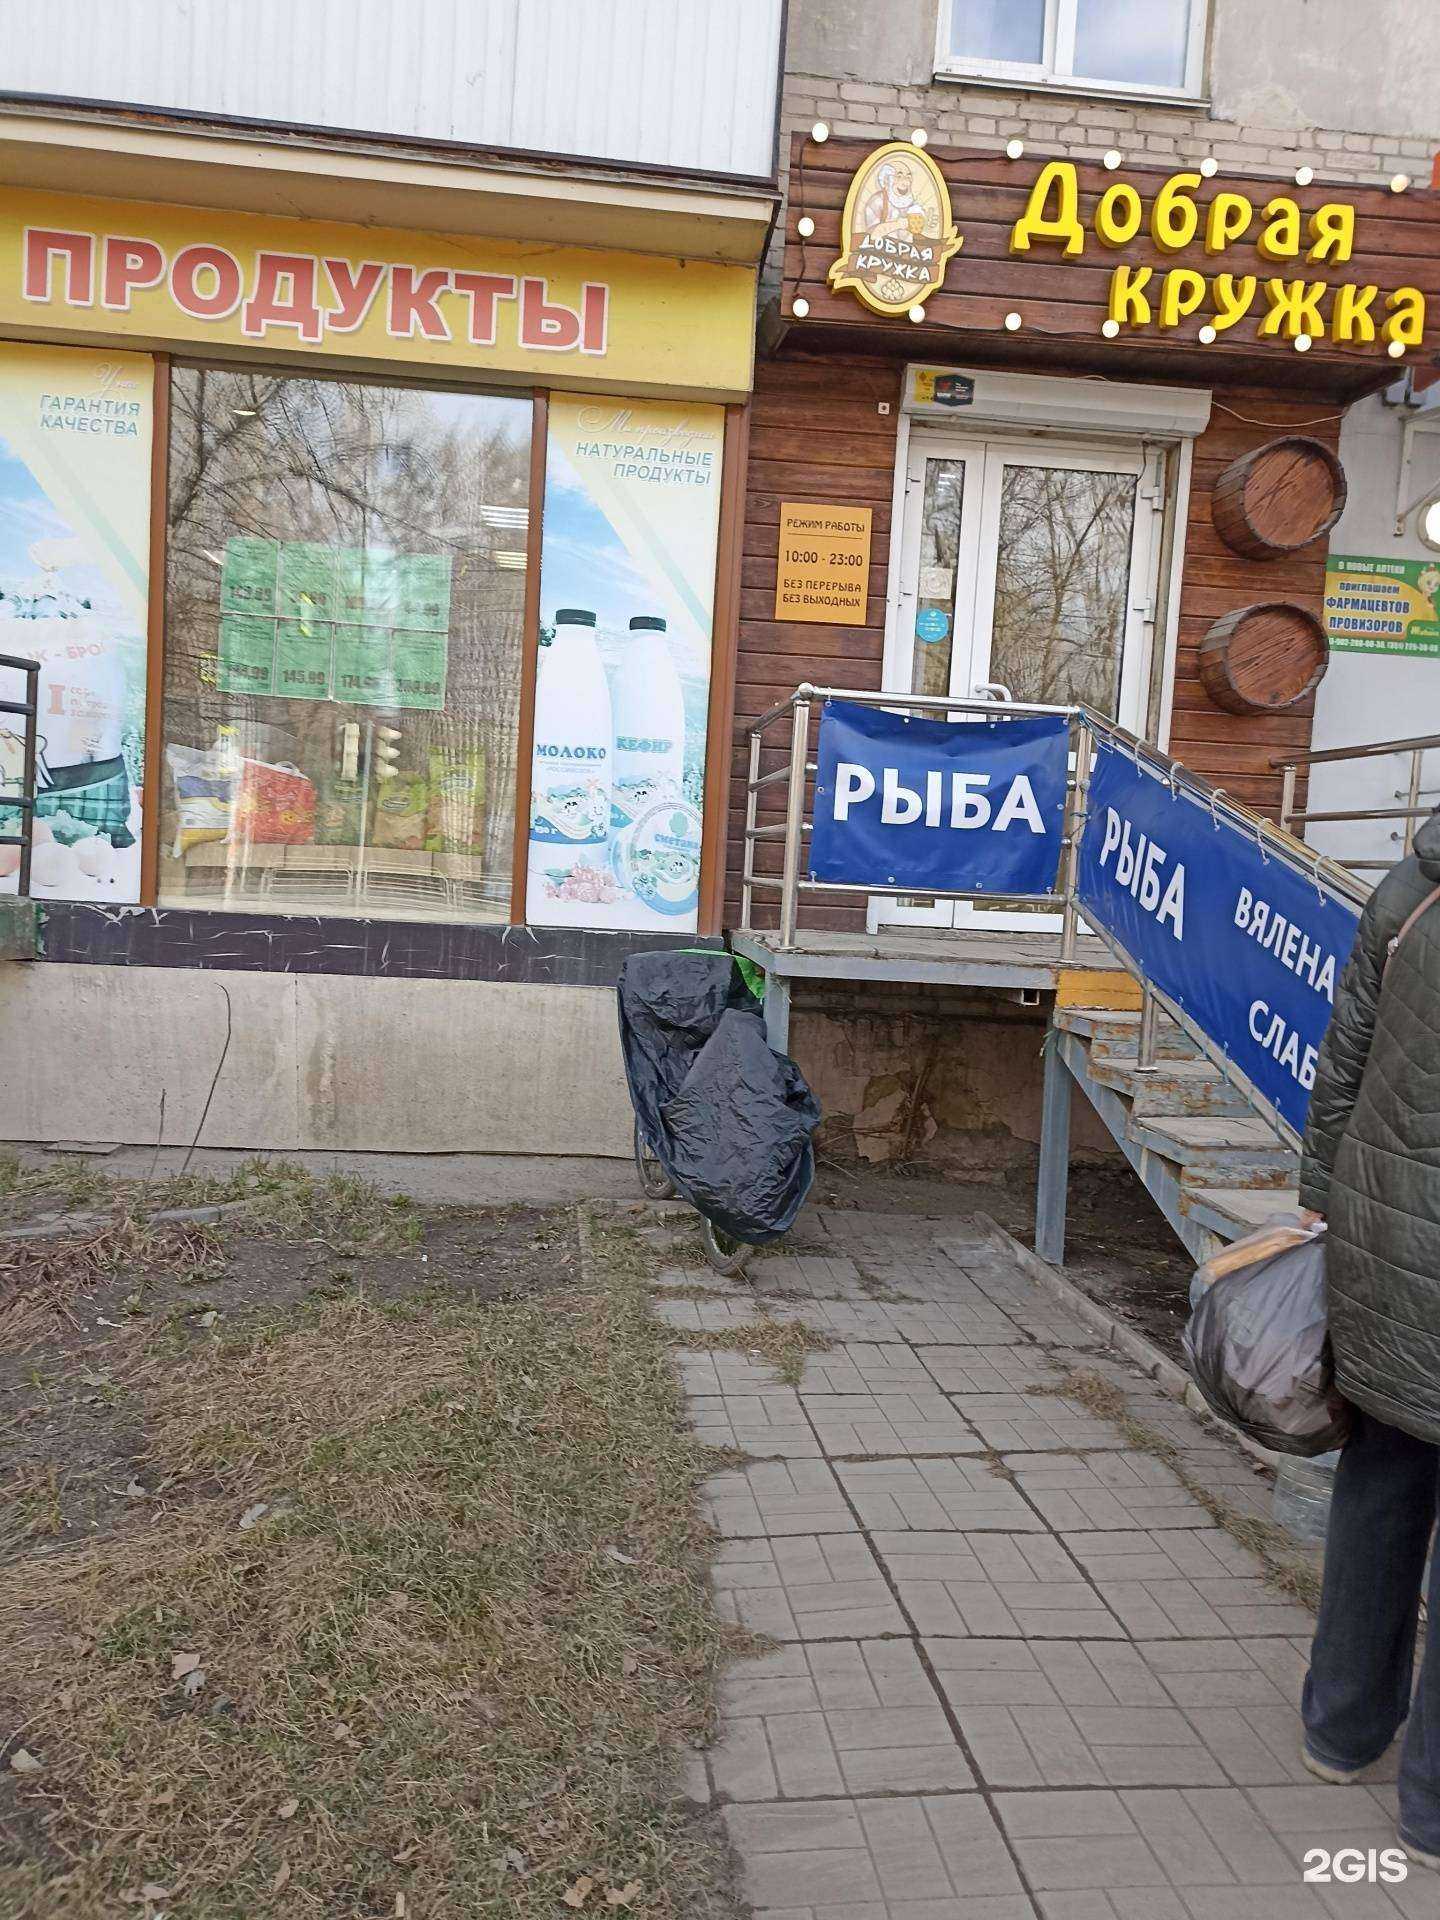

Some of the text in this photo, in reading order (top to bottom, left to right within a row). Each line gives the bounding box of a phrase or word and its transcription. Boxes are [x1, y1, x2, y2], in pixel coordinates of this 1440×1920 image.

[1010, 162, 1355, 265] Добрая
[859, 234, 934, 261] ДОБРАЯ
[855, 254, 931, 281] КРУЖКА
[23, 226, 610, 355] ПРОДУКТЫ
[1108, 265, 1427, 346] кружка
[40, 394, 141, 416] ГАРАНТИЯ
[40, 414, 138, 436] КАЧЕСТВА
[576, 441, 713, 467] НАТУРАЛЬНЫЕ
[613, 463, 711, 485] ПРОДУКТЫ
[787, 518, 865, 533] РЕЖИМ РАБОТЫ
[786, 549, 818, 564] 10:00
[829, 552, 863, 567] 23:00
[783, 578, 862, 593] БЕЗ ПЕРЕРЫВА
[782, 593, 860, 607] БЕЗ ВЫХОДНЫХ
[1326, 597, 1410, 614] ФАРМАЦЕВТОВ
[1329, 616, 1403, 633] ПРОВИЗОРОВ
[536, 743, 607, 760] МОЛОКО
[833, 762, 1046, 834] РЫБА
[1099, 806, 1185, 941] РЫБА
